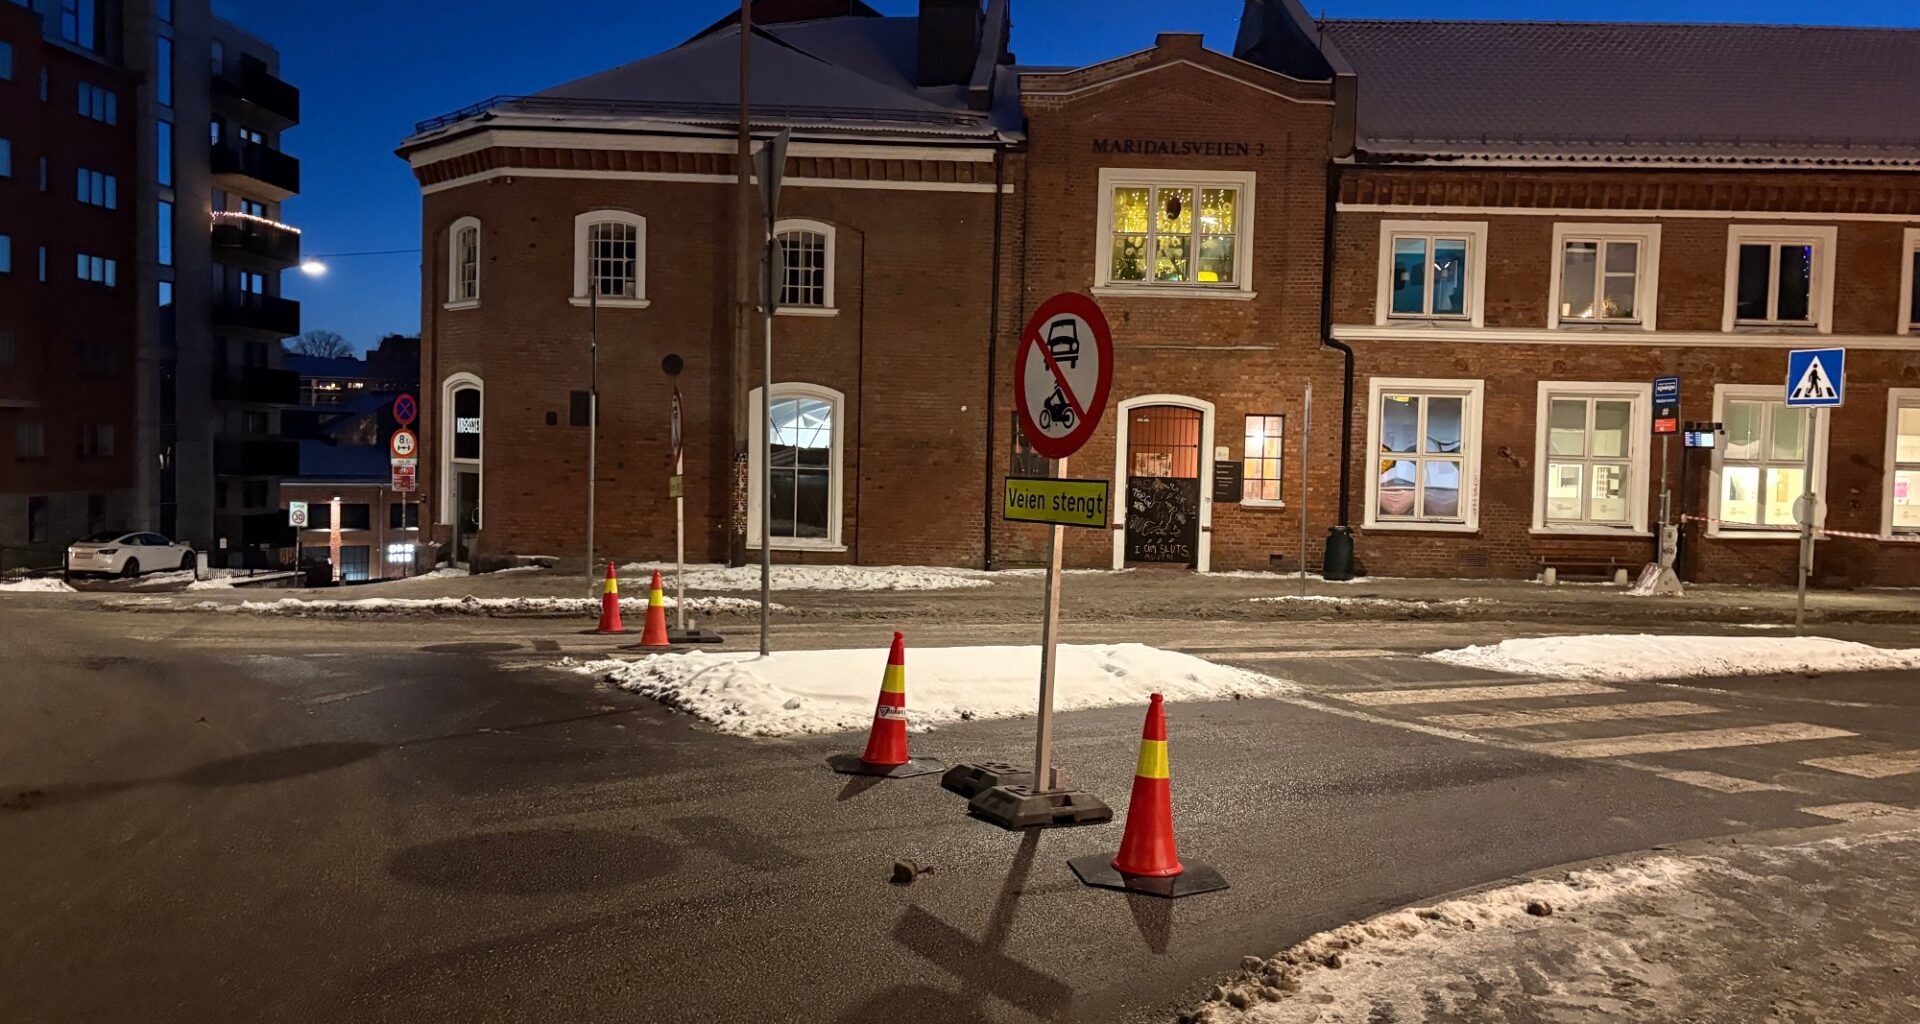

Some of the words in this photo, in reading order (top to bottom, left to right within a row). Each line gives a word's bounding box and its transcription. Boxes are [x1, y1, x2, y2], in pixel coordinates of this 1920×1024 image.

[1092, 138, 1249, 156] MARIDALSVEIEN
[1255, 142, 1265, 157] 3
[399, 434, 405, 444] 8
[1008, 487, 1045, 510] Veien
[1052, 492, 1103, 518] stengt
